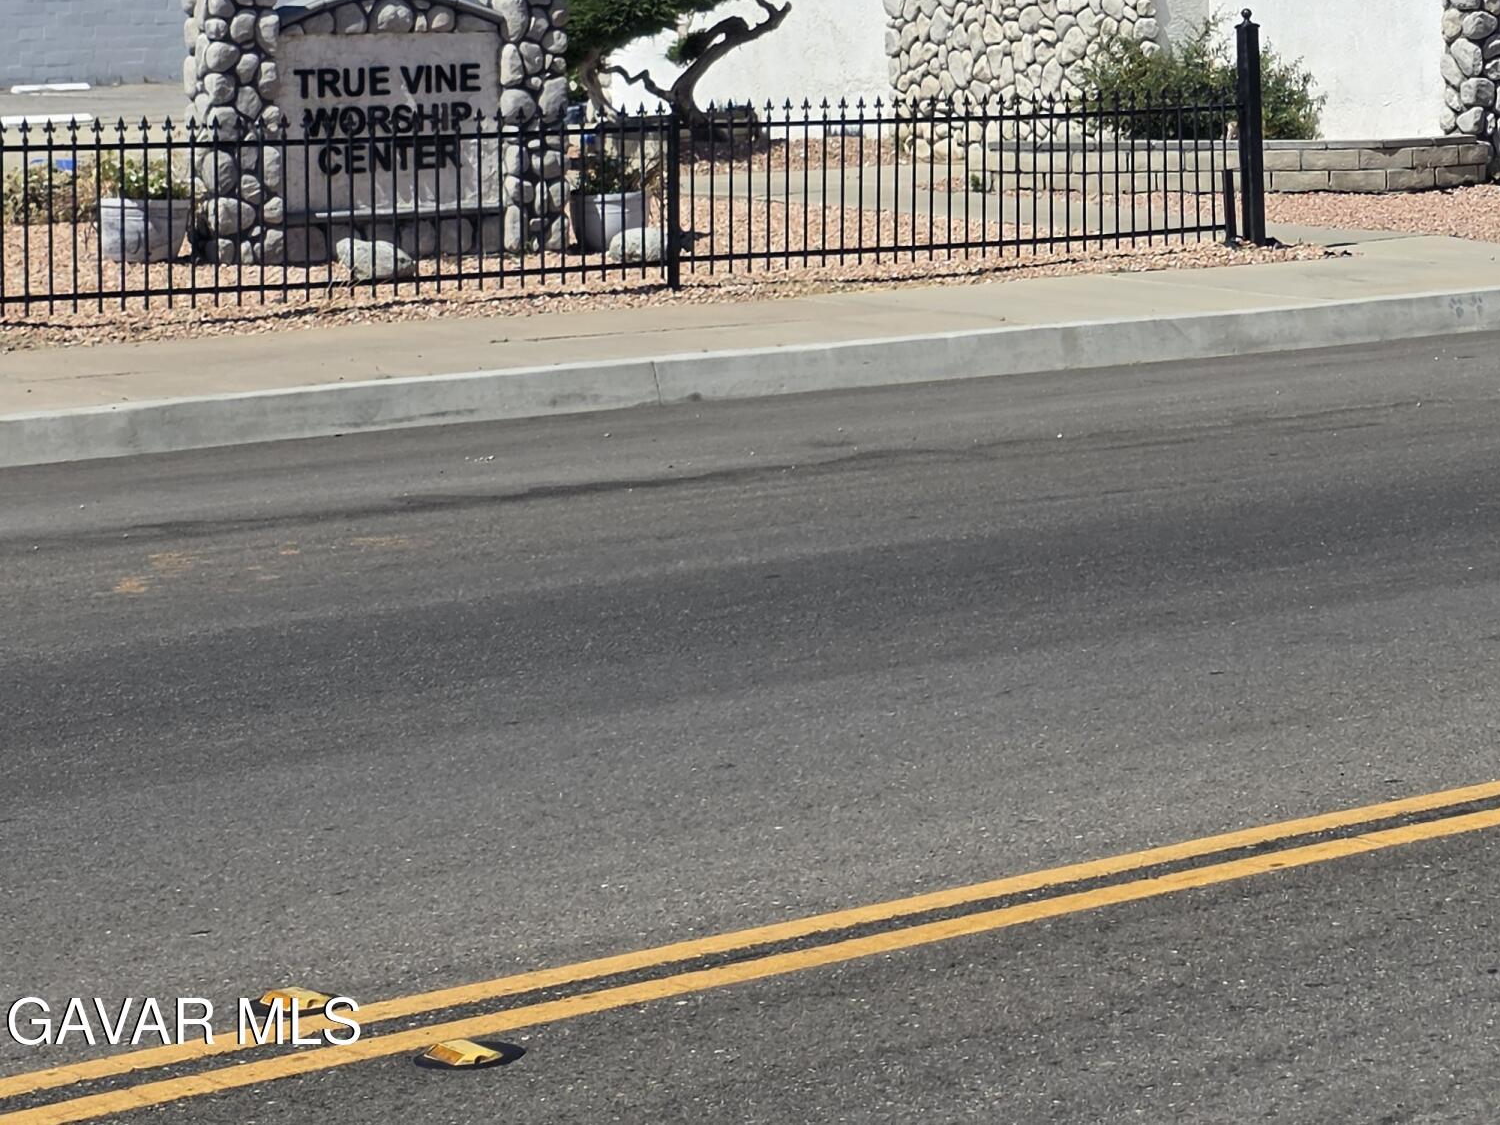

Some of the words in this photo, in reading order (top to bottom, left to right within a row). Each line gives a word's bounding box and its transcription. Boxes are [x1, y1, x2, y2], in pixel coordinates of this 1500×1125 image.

[294, 66, 390, 99] TRUE
[401, 63, 481, 93] VINE
[303, 102, 472, 138] WORSHIP
[318, 140, 461, 175] CENTER
